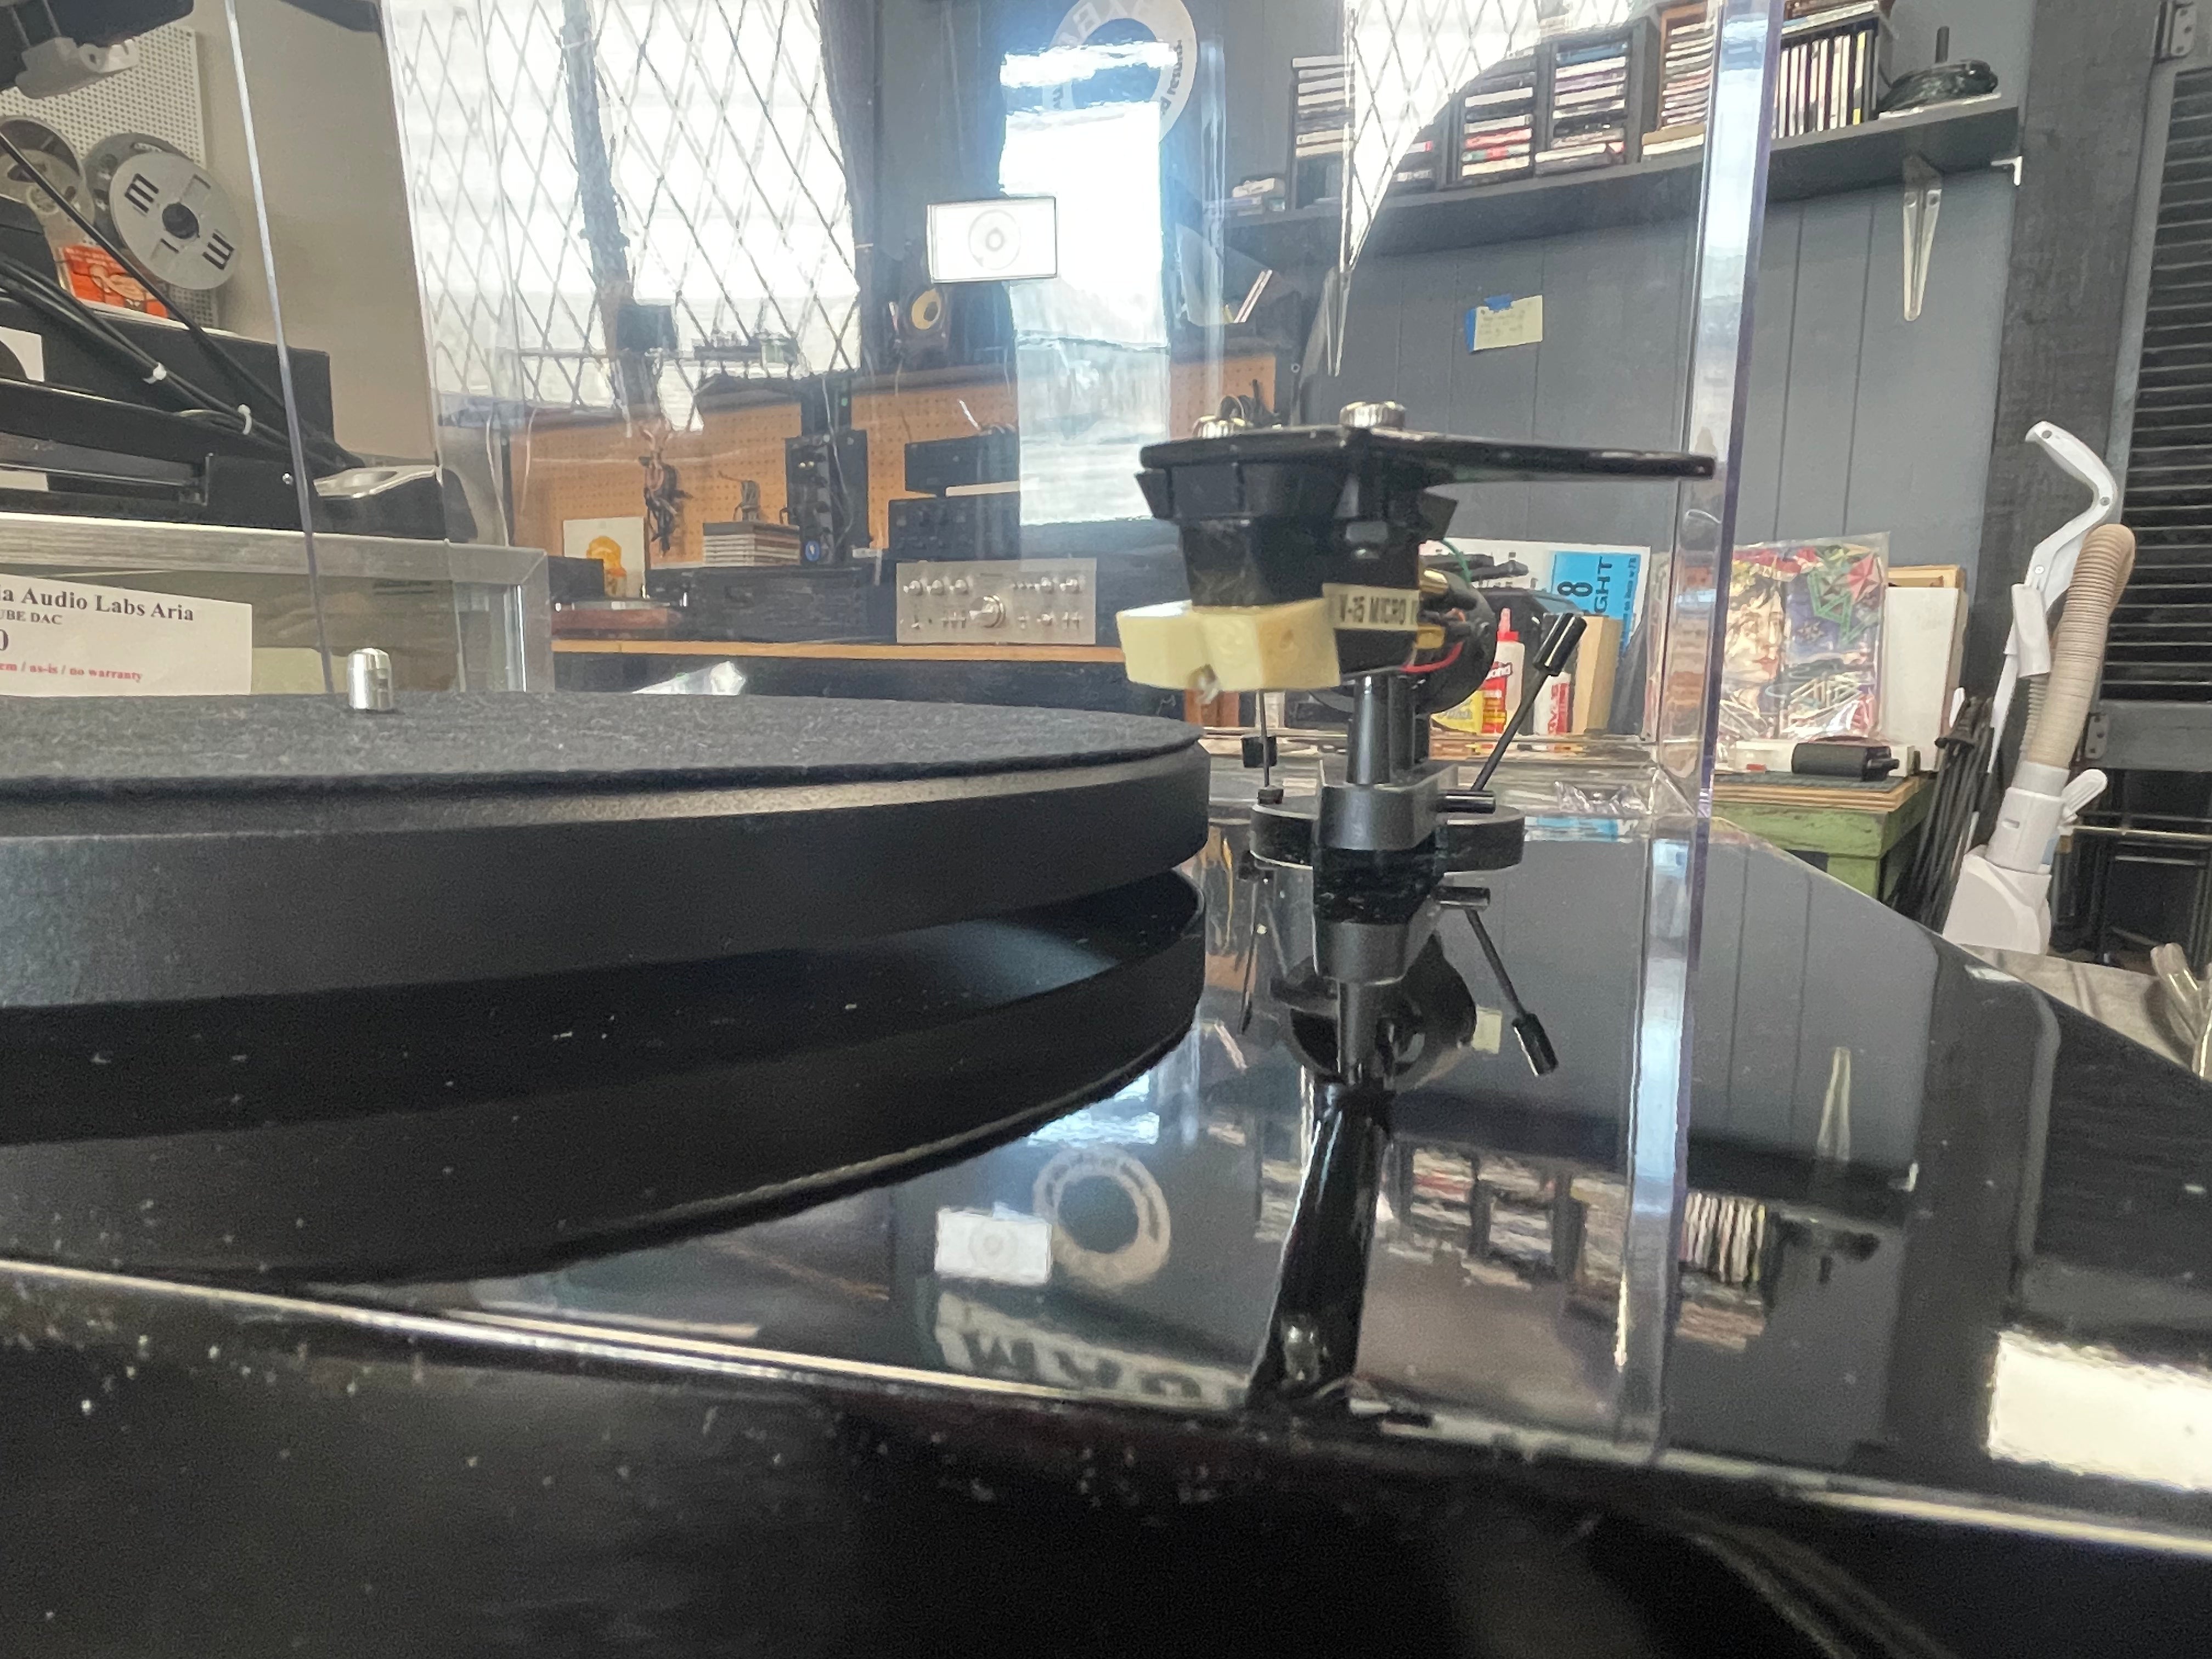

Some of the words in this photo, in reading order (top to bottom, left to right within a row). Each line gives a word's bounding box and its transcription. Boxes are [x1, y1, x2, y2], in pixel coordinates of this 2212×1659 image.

[21, 587, 88, 610] Audio
[94, 595, 146, 616] Labs
[150, 602, 194, 621] Aria
[31, 612, 63, 625] DAC
[70, 668, 84, 676] no
[88, 669, 143, 684] warranty
